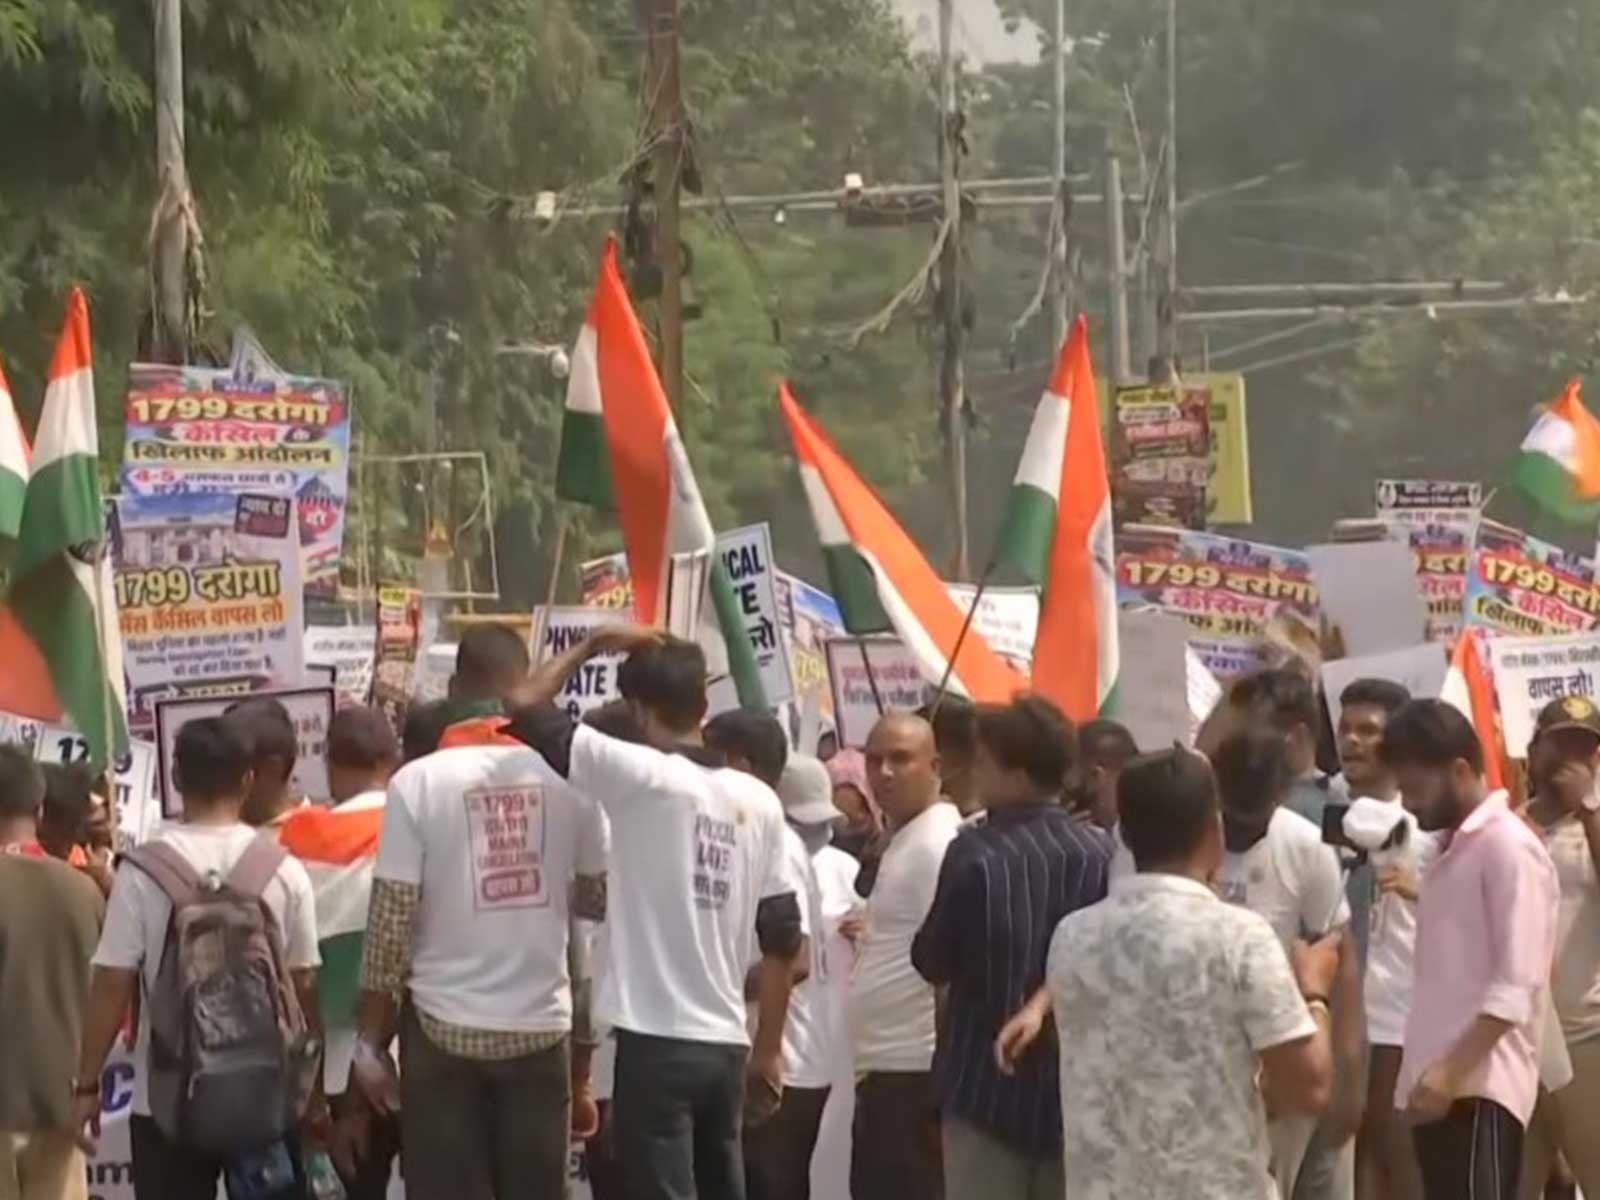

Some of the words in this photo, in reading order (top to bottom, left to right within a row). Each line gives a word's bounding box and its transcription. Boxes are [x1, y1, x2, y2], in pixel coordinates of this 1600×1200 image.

[131, 396, 229, 423] 1799
[232, 394, 331, 425] दरोगा
[114, 565, 189, 608] 1799
[191, 555, 282, 603] दरोगा
[1125, 561, 1221, 588] 1799
[1482, 556, 1555, 594] 1799
[564, 663, 607, 697] ATE
[1528, 675, 1564, 700] वापस
